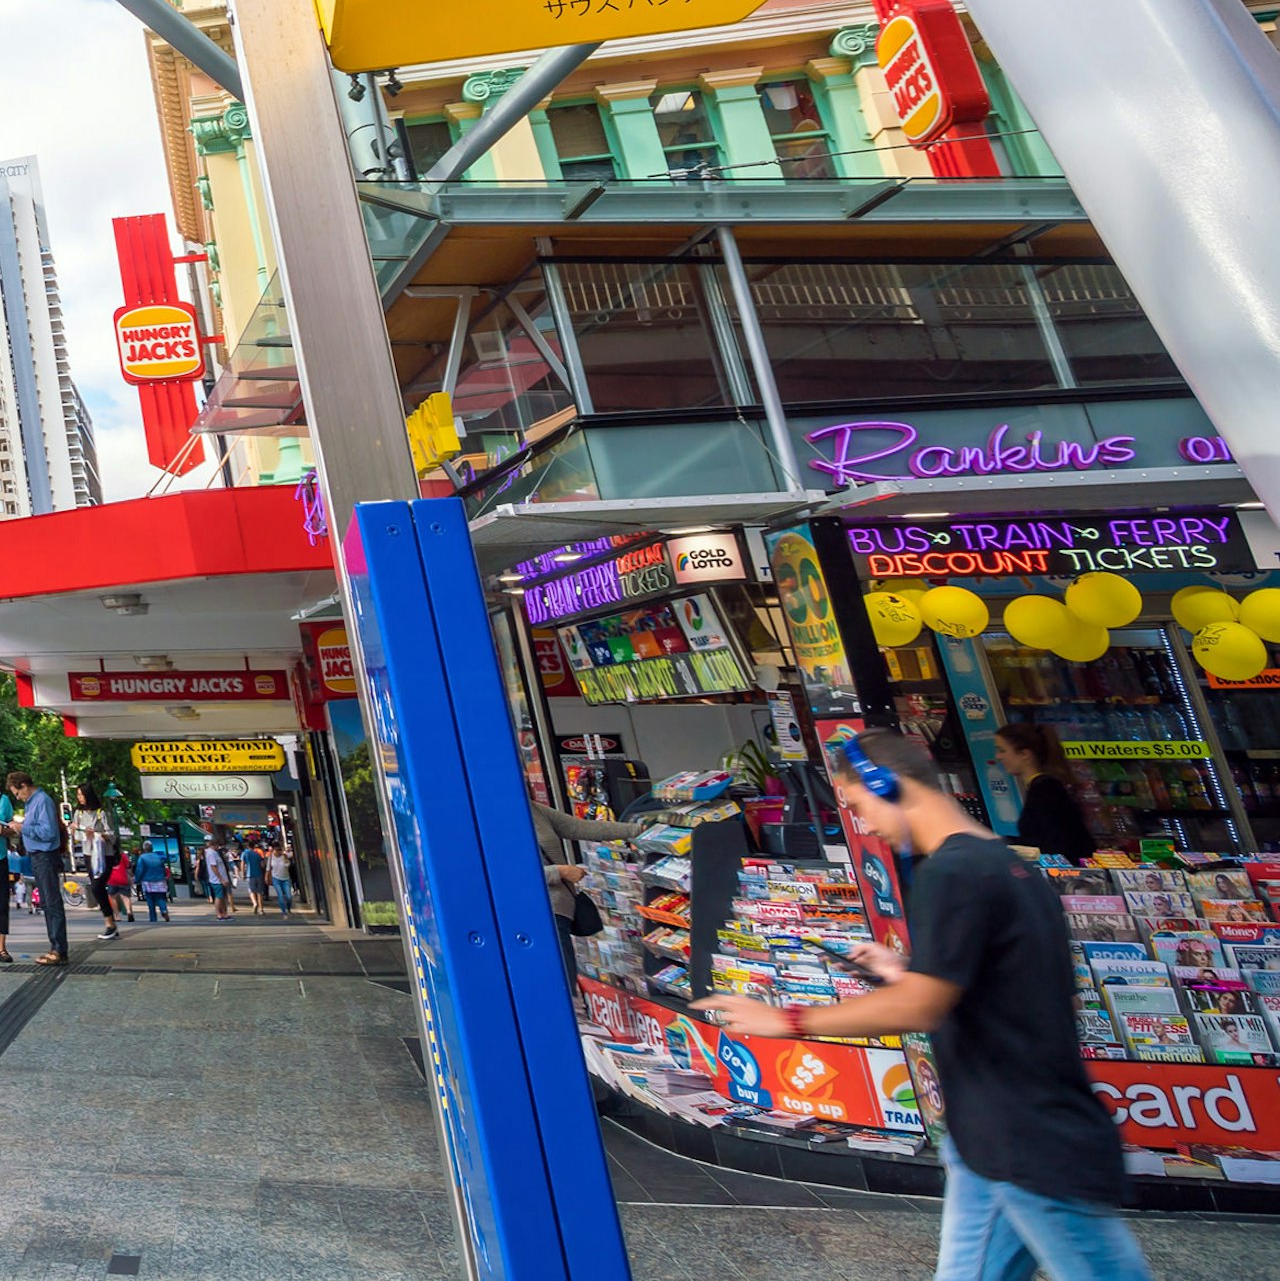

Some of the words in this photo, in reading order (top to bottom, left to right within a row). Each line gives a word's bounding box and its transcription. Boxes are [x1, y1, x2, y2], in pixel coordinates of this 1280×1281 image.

[122, 325, 191, 343] HUNGRY
[126, 340, 196, 362] JACK'S
[807, 420, 1136, 486] Rankins
[848, 526, 930, 554] BUS
[952, 521, 1076, 549] TRAIN
[1111, 517, 1229, 547] FERRY
[689, 548, 726, 559] GOLD
[869, 550, 1049, 576] DISCOUNT
[1059, 545, 1218, 571] TICKETS
[692, 558, 733, 569] LOTTO
[620, 565, 669, 598] TICKETS
[793, 623, 837, 643] MILLION
[110, 677, 187, 693] HUNGRY
[190, 677, 244, 693] JACK'S
[141, 753, 232, 764] EXCHANGE
[1089, 744, 1151, 756] Waters
[1153, 744, 1203, 757] $5.00
[165, 778, 247, 796] RINGLEADERS
[1221, 925, 1258, 939] Money
[591, 993, 625, 1034] card
[1133, 1023, 1188, 1033] FITESS
[736, 1081, 758, 1104] buy
[783, 1095, 814, 1115] top
[818, 1103, 845, 1118] up
